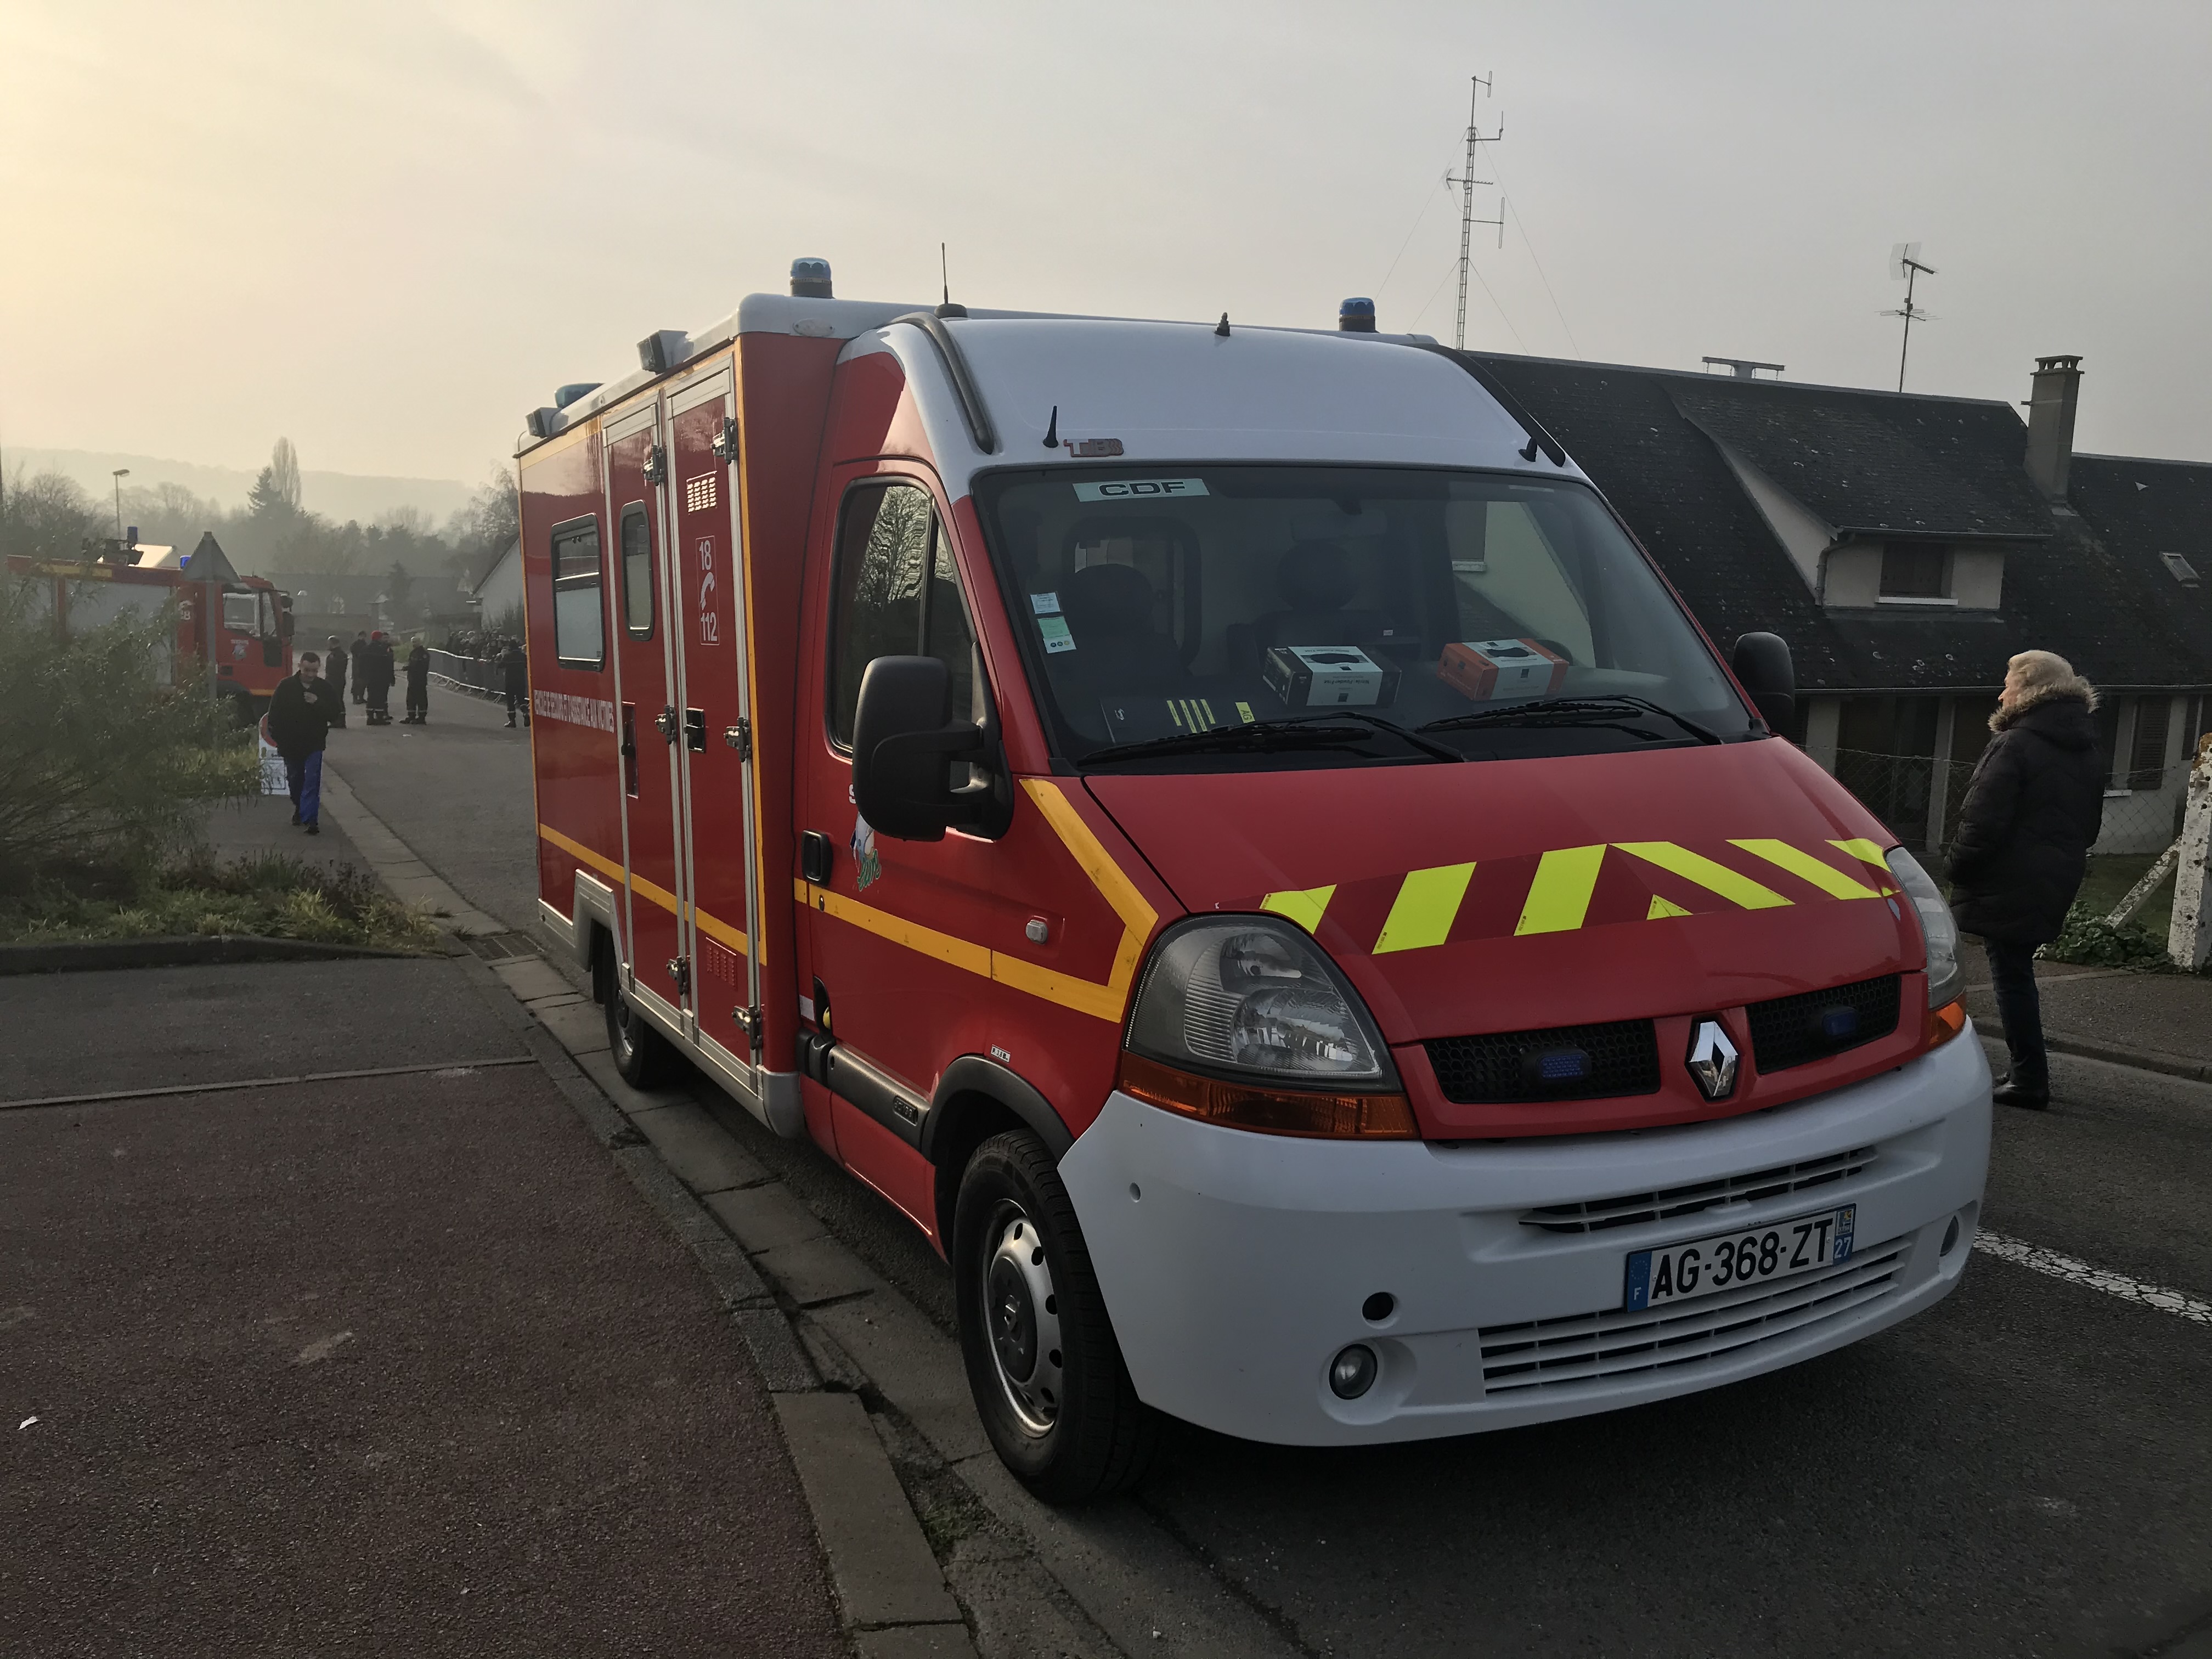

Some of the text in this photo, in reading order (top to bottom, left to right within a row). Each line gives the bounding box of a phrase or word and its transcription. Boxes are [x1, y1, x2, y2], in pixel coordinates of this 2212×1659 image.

[1098, 481, 1185, 496] CDF
[699, 540, 712, 570] 18
[701, 612, 718, 641] 112
[1651, 1217, 1833, 1300] AG-368-ZT
[1833, 1237, 1851, 1259] 27
[1633, 1286, 1641, 1301] F
